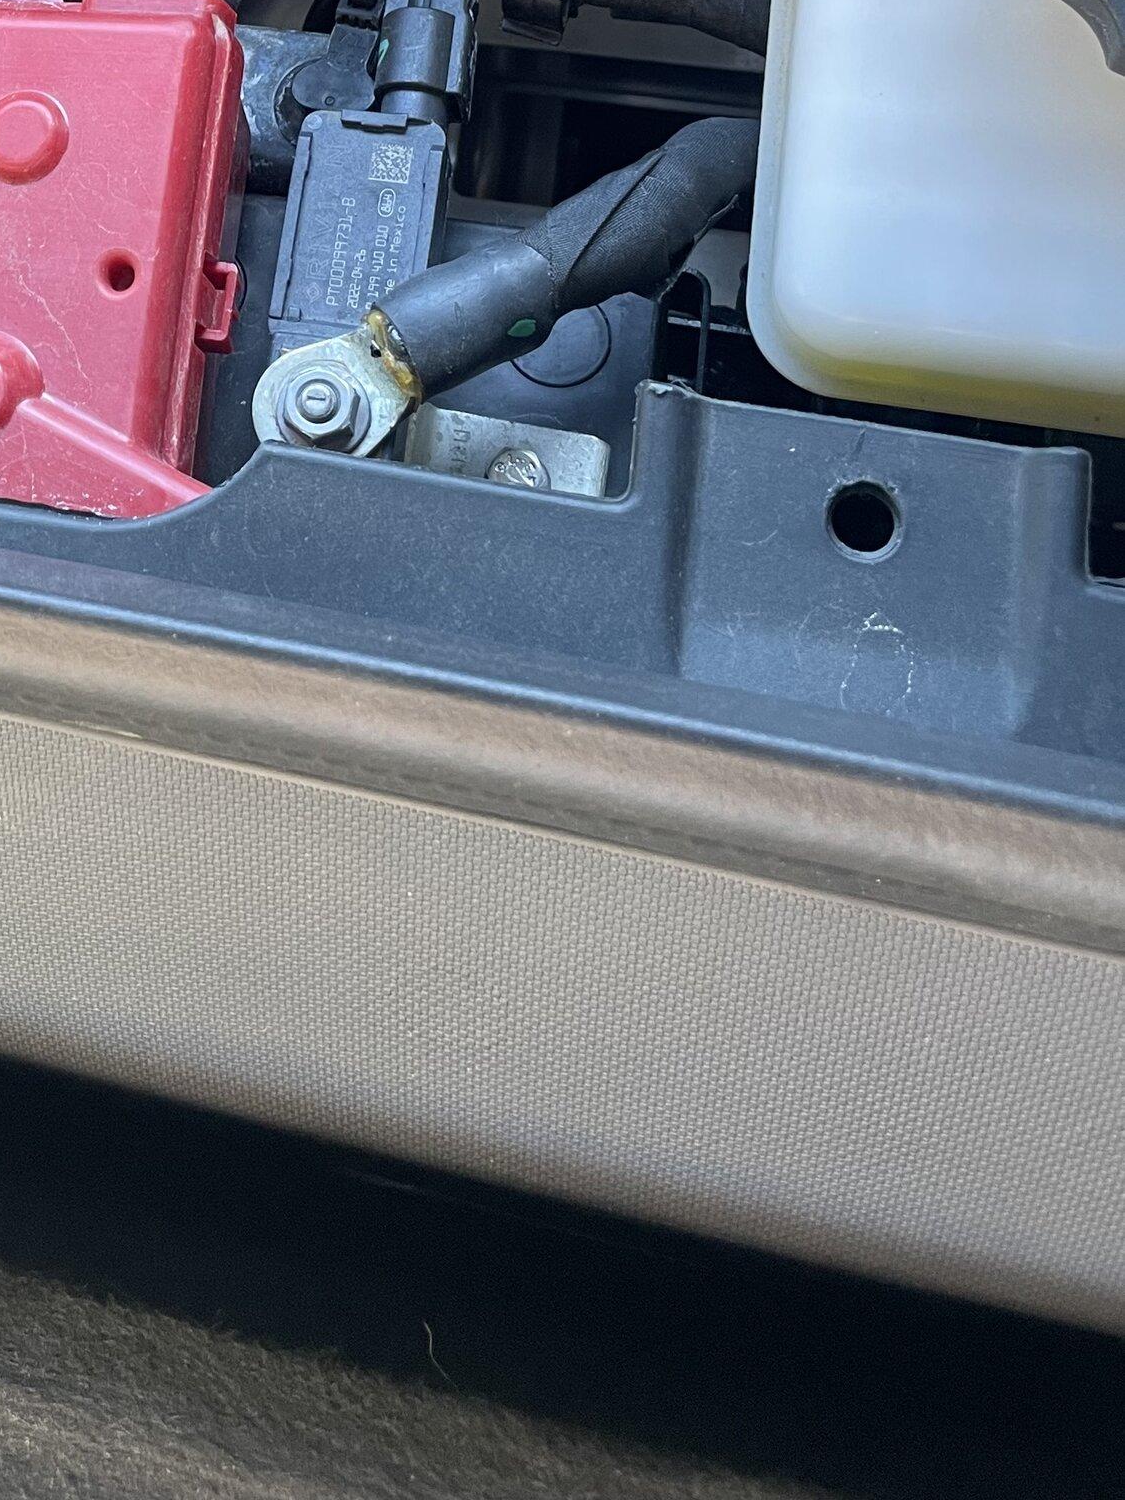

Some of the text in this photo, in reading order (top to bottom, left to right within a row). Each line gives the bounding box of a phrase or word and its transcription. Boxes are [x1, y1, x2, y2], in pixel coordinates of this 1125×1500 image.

[305, 144, 347, 280] RIVIAN
[376, 225, 389, 247] 010
[389, 206, 406, 254] Mexico
[326, 198, 355, 307] PT00099731-B
[372, 251, 385, 272] 410
[387, 259, 398, 273] in
[347, 249, 366, 309] 2022-04-26
[367, 276, 381, 297] 199
